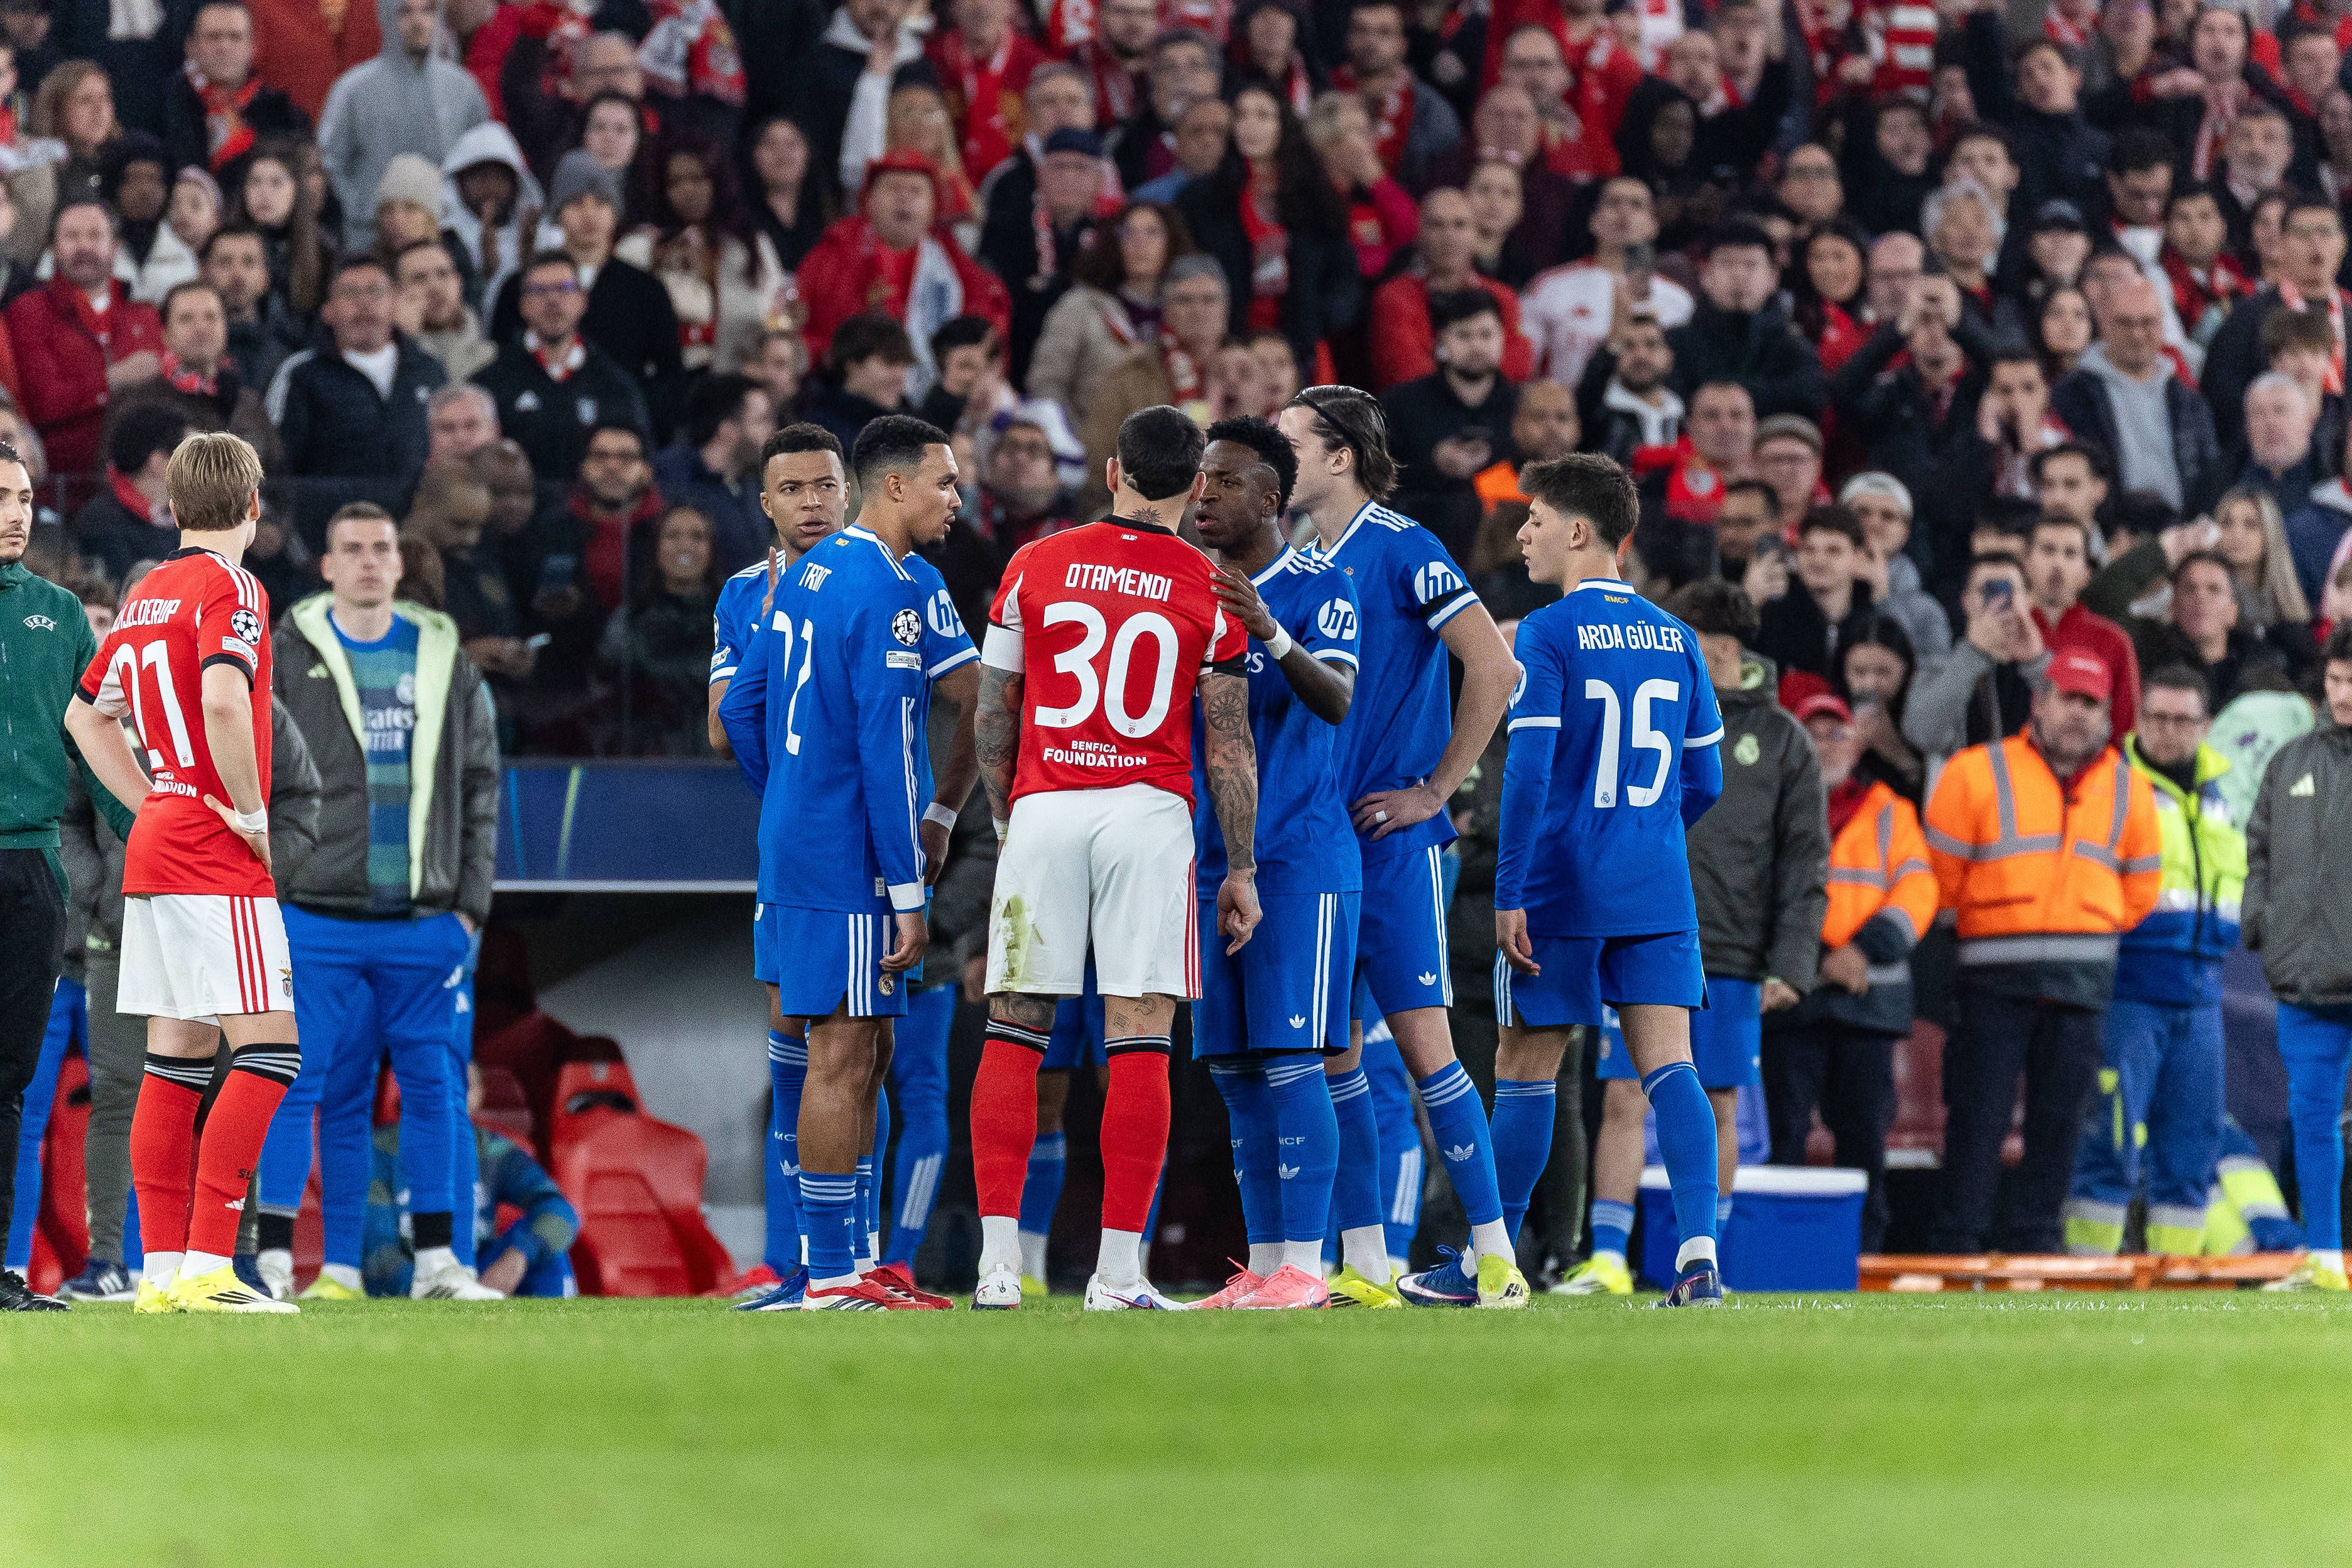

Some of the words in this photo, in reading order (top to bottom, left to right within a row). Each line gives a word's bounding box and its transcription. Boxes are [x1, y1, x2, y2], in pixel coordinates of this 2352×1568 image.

[1065, 563, 1173, 602] OTAMENDI
[24, 616, 55, 631] UEFA
[902, 620, 917, 635] 15
[1320, 597, 1355, 640] hp
[1577, 624, 1625, 650] ARDA
[1626, 621, 1684, 653] GÜLER
[1034, 601, 1179, 738] 30
[1043, 748, 1147, 768] FOUNDATION
[1071, 740, 1118, 754] BENFICA
[1586, 678, 1679, 808] 15
